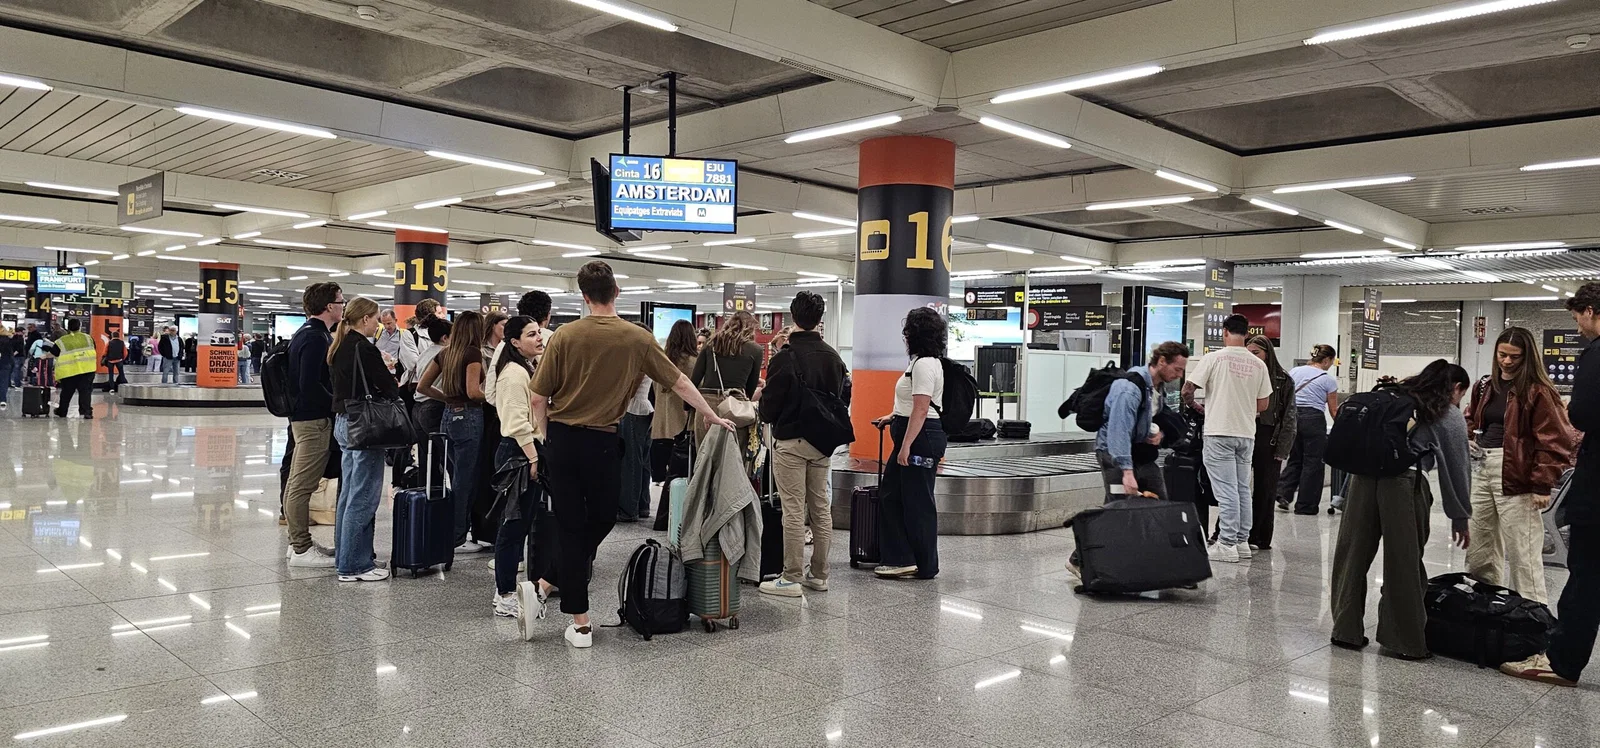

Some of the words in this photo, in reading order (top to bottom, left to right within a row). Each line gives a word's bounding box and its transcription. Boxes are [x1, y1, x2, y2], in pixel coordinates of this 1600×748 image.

[614, 168, 640, 179] Cinta
[643, 163, 662, 180] 16
[706, 163, 725, 172] EJU
[706, 173, 733, 184] 7881
[616, 183, 732, 203] AMSTERDAM
[410, 258, 448, 292] 15
[206, 279, 239, 305] 15
[28, 297, 51, 313] 14
